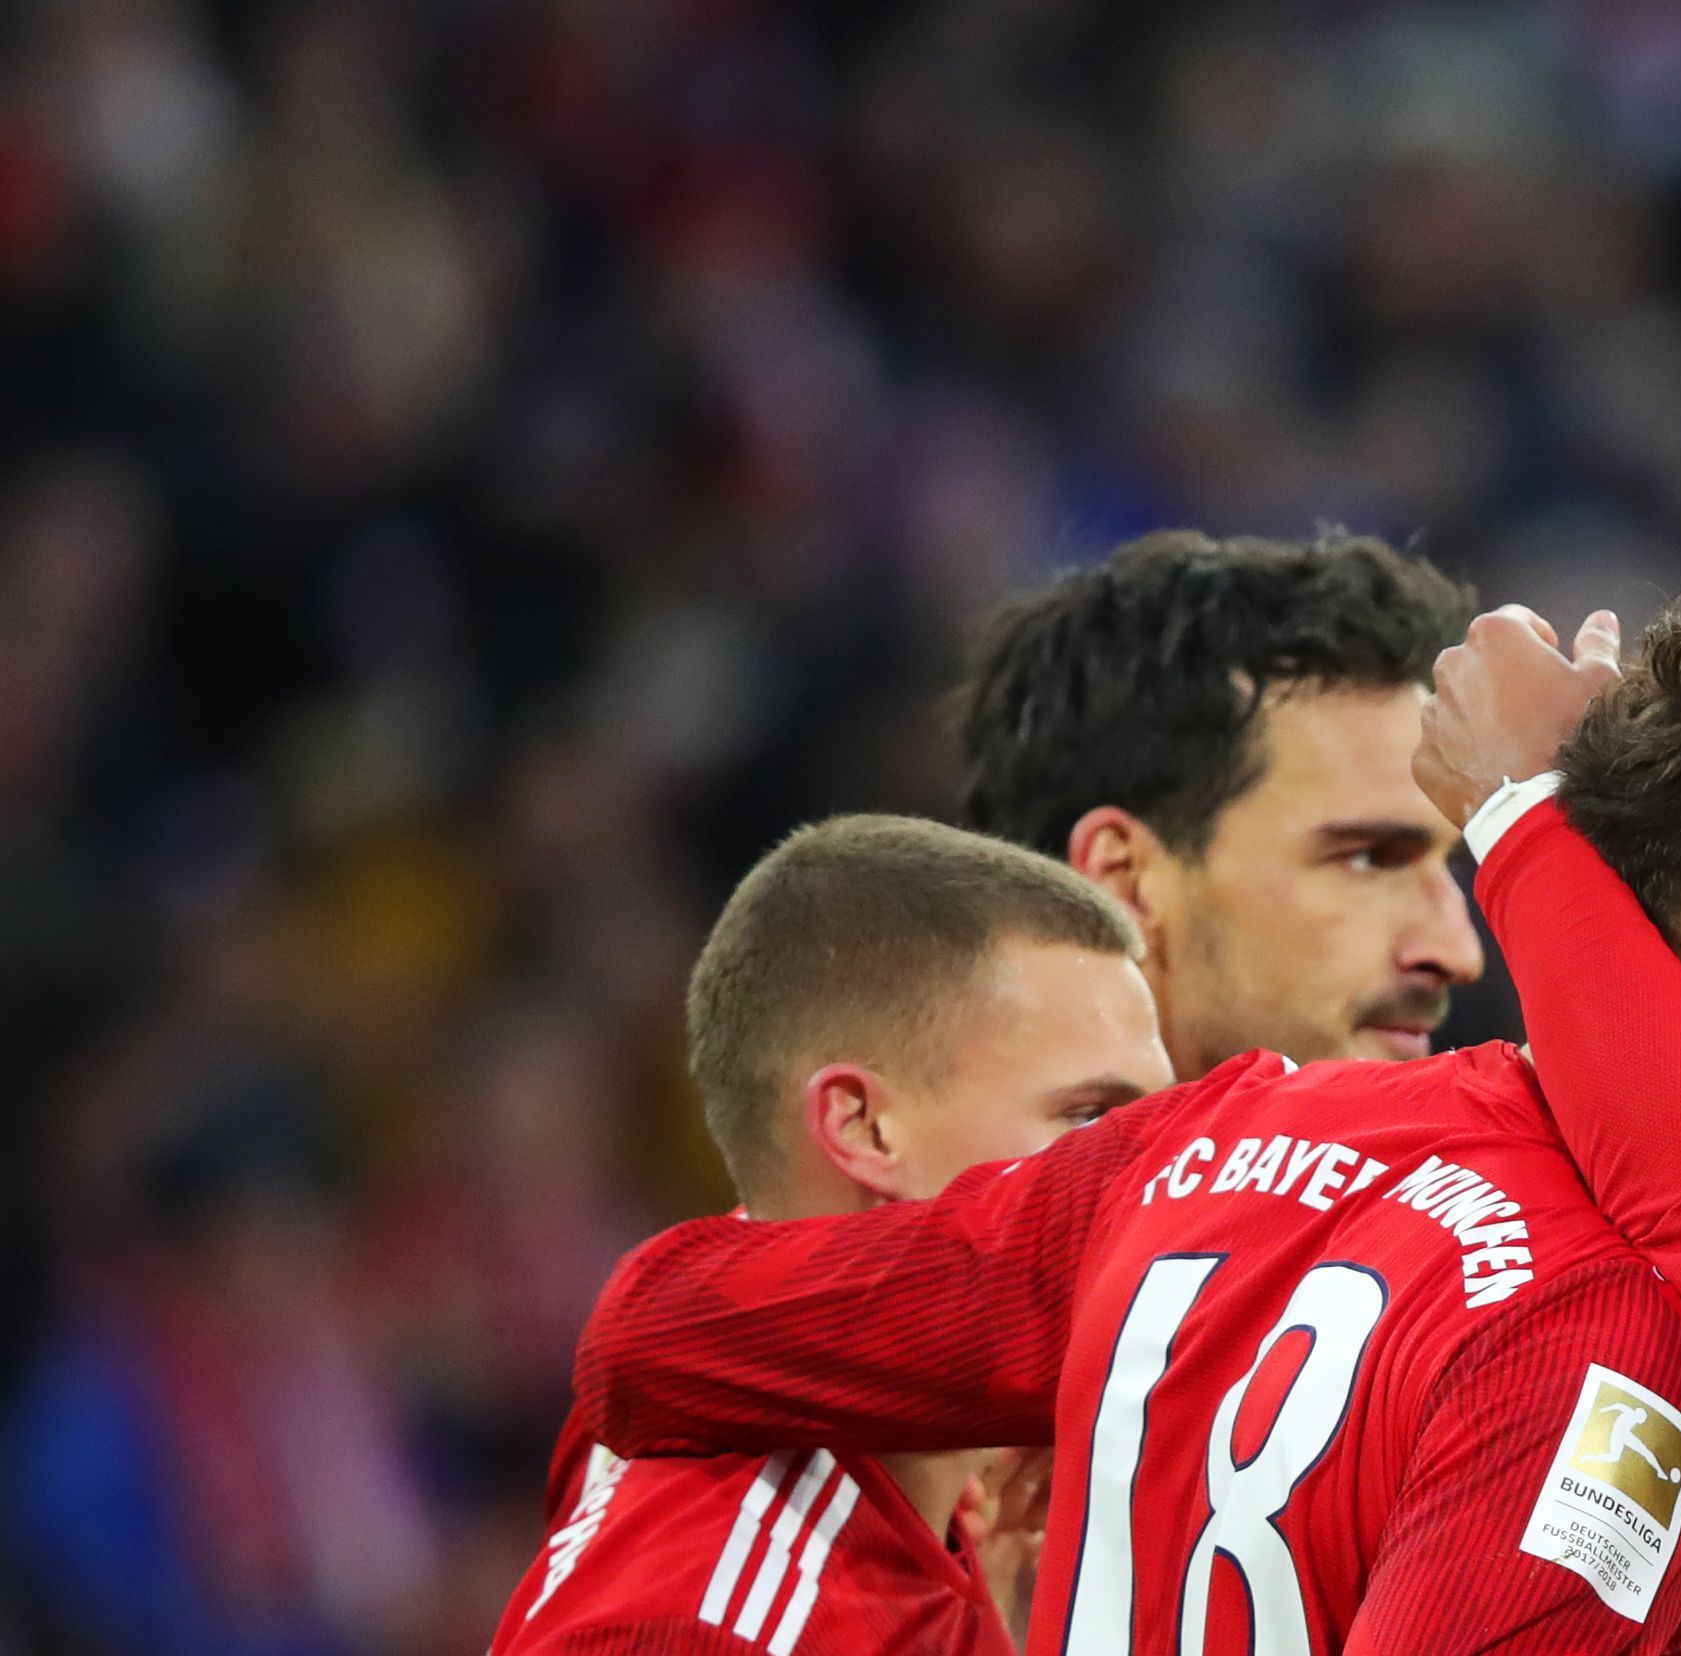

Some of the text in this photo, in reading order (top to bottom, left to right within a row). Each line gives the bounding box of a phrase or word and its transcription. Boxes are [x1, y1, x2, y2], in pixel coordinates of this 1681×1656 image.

[1560, 1476, 1663, 1554] BUNDESLIGA
[1569, 1520, 1631, 1571] DEUTSCHER
[1542, 1523, 1642, 1597] FUSSBALLMEISTER
